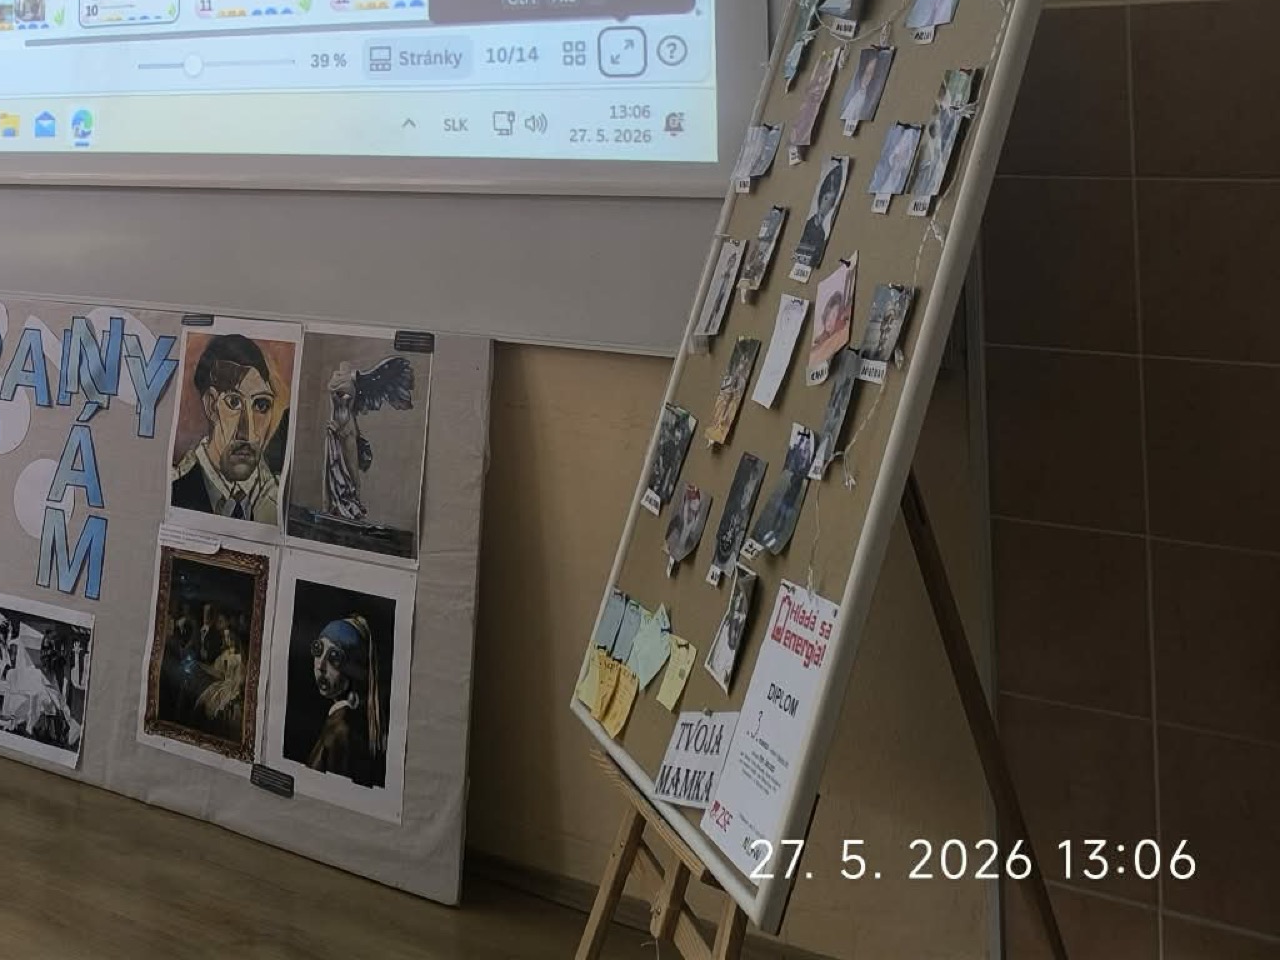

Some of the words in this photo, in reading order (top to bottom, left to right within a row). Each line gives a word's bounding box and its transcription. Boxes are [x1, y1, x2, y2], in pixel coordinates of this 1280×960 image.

[86, 4, 99, 17] 10
[199, 0, 212, 12] 11
[310, 53, 330, 68] 39
[333, 53, 347, 68] %
[399, 48, 462, 69] Stránky
[485, 46, 540, 64] 10/14
[609, 104, 651, 120] 13:06
[443, 118, 468, 132] SLK
[569, 128, 591, 143] 27.
[596, 128, 609, 143] 5.
[614, 128, 652, 143] 2026
[767, 683, 799, 718] DIPLOM
[676, 719, 724, 756] TVOJA
[654, 764, 715, 802] MAMKA
